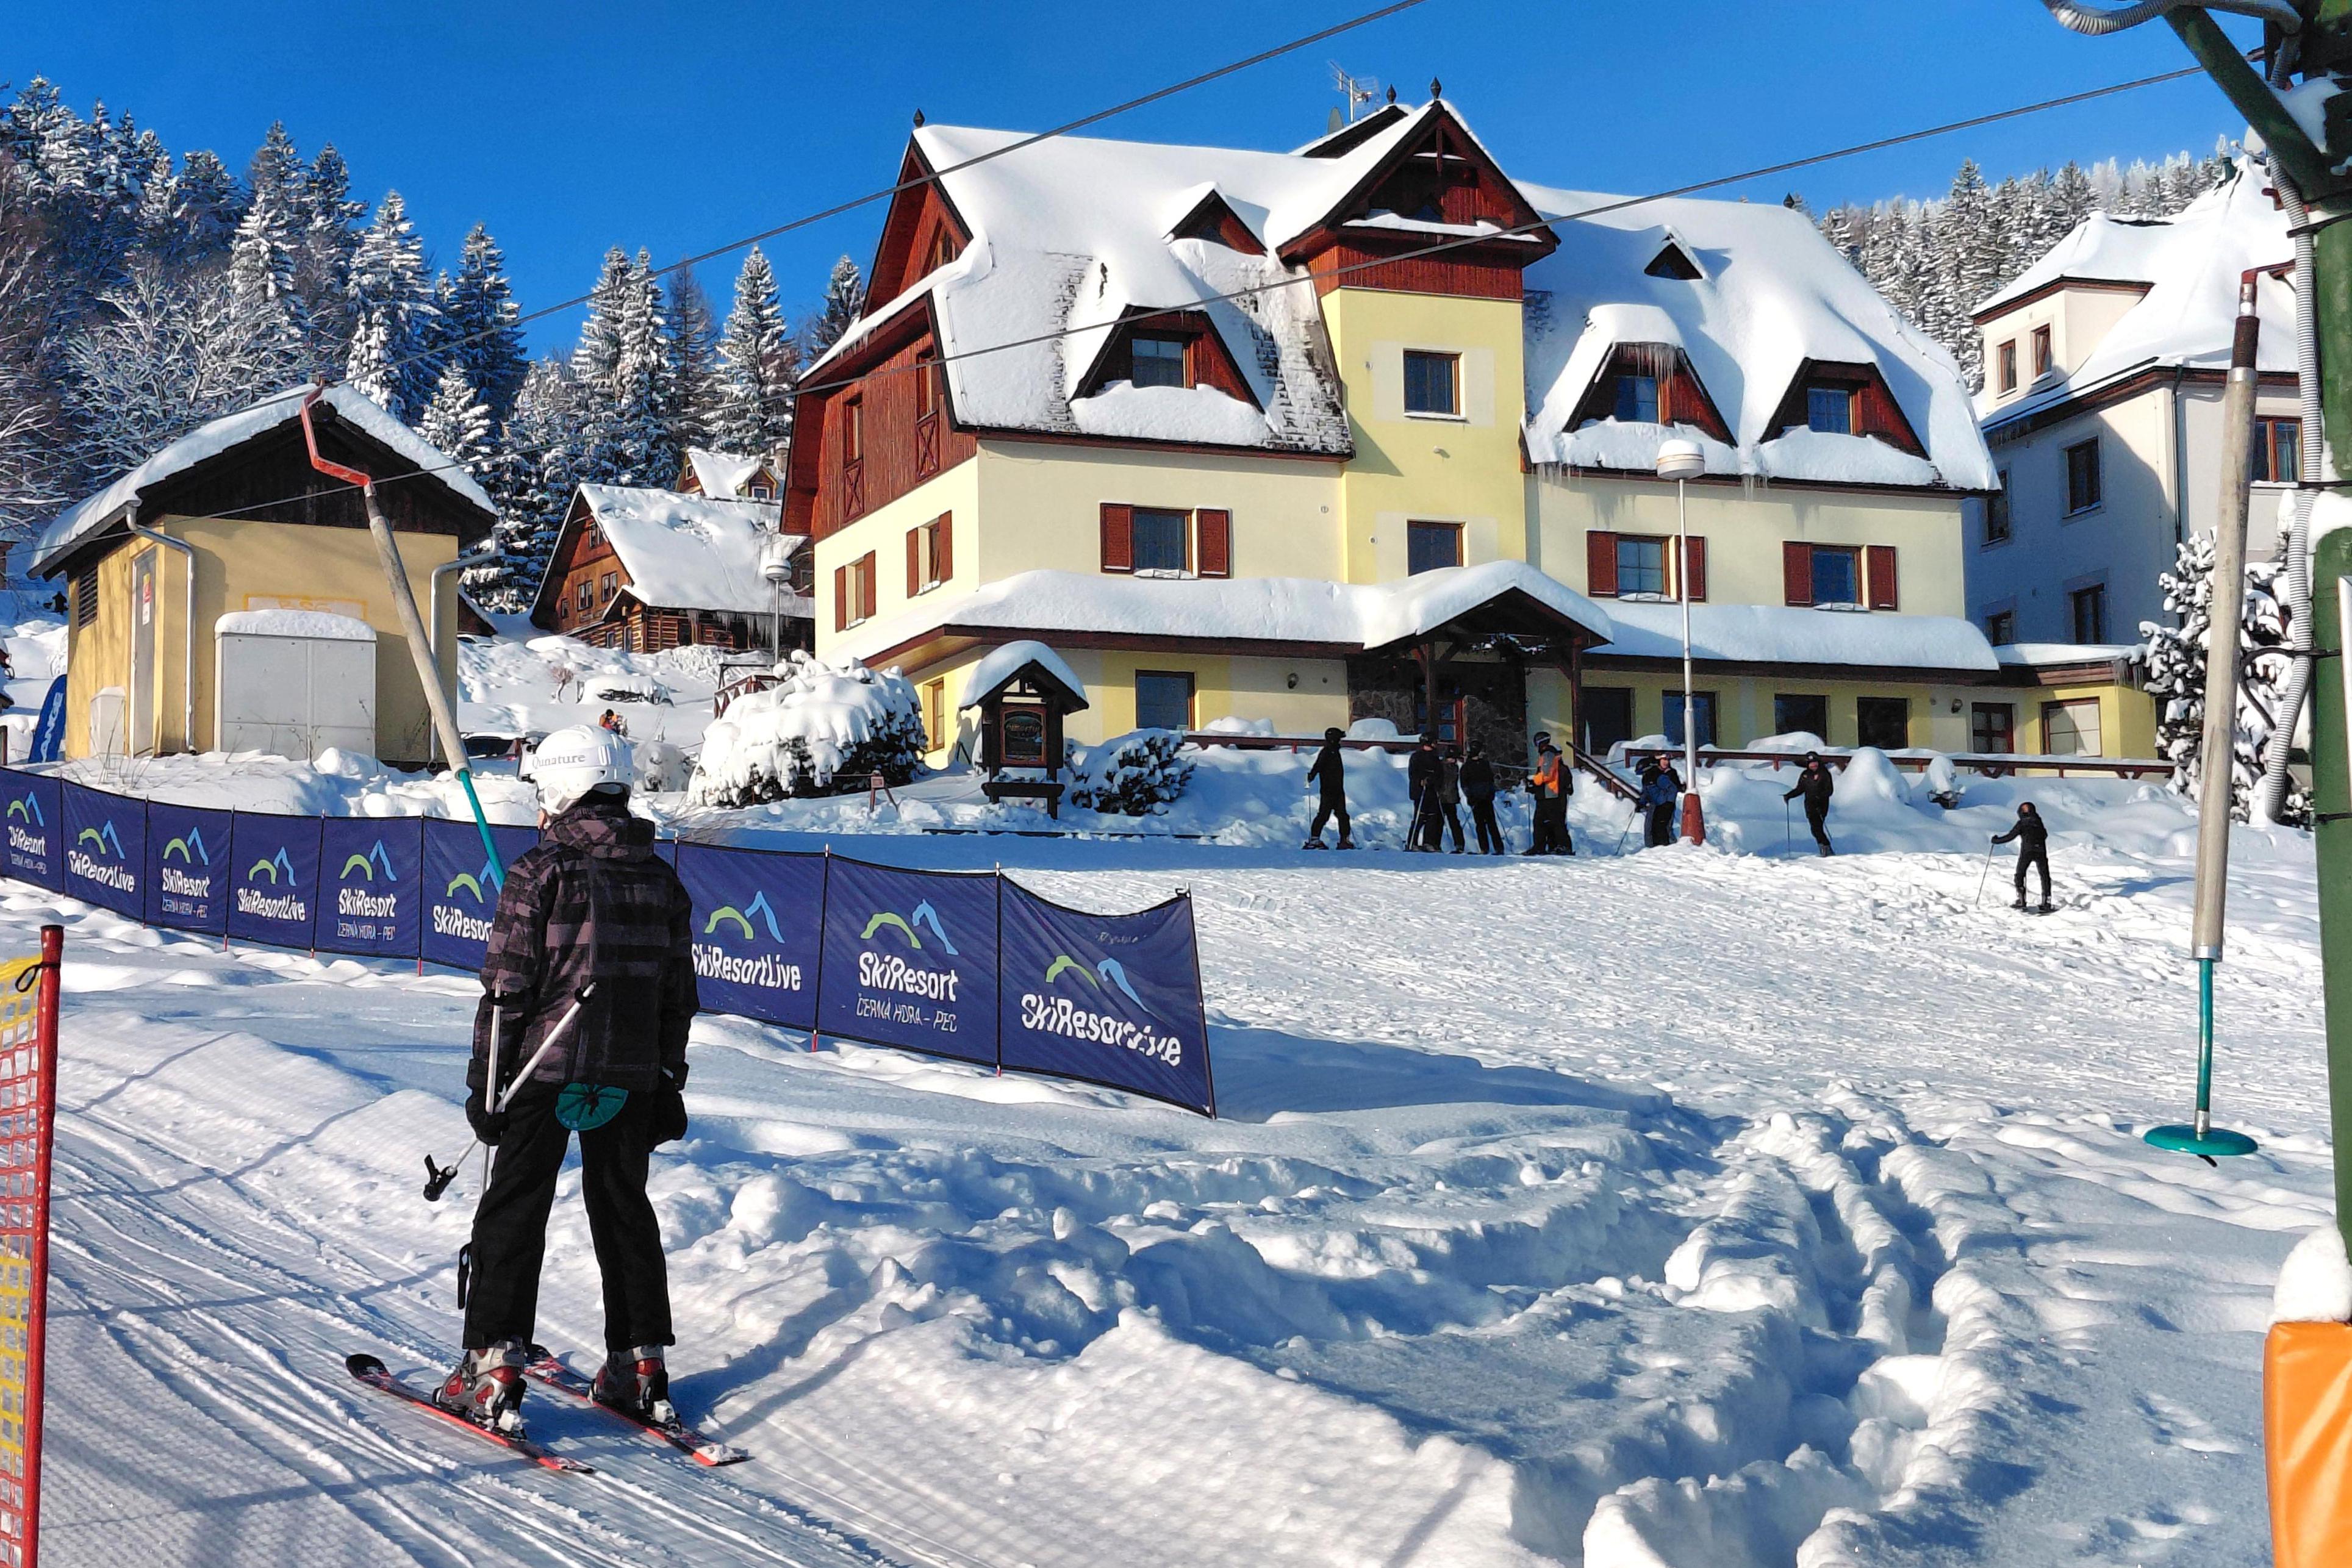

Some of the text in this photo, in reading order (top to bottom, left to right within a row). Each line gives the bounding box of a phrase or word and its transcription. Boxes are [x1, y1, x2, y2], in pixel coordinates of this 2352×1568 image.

[162, 867, 210, 898] SkiResort
[237, 887, 306, 922] SkiResortLive
[339, 888, 397, 918] SkiResort
[691, 943, 802, 992] SkiResortLive
[859, 951, 959, 1003] SkiResort
[856, 992, 891, 1021] ČERNÁ
[892, 1003, 923, 1026] HORA
[933, 1010, 958, 1033] PEC
